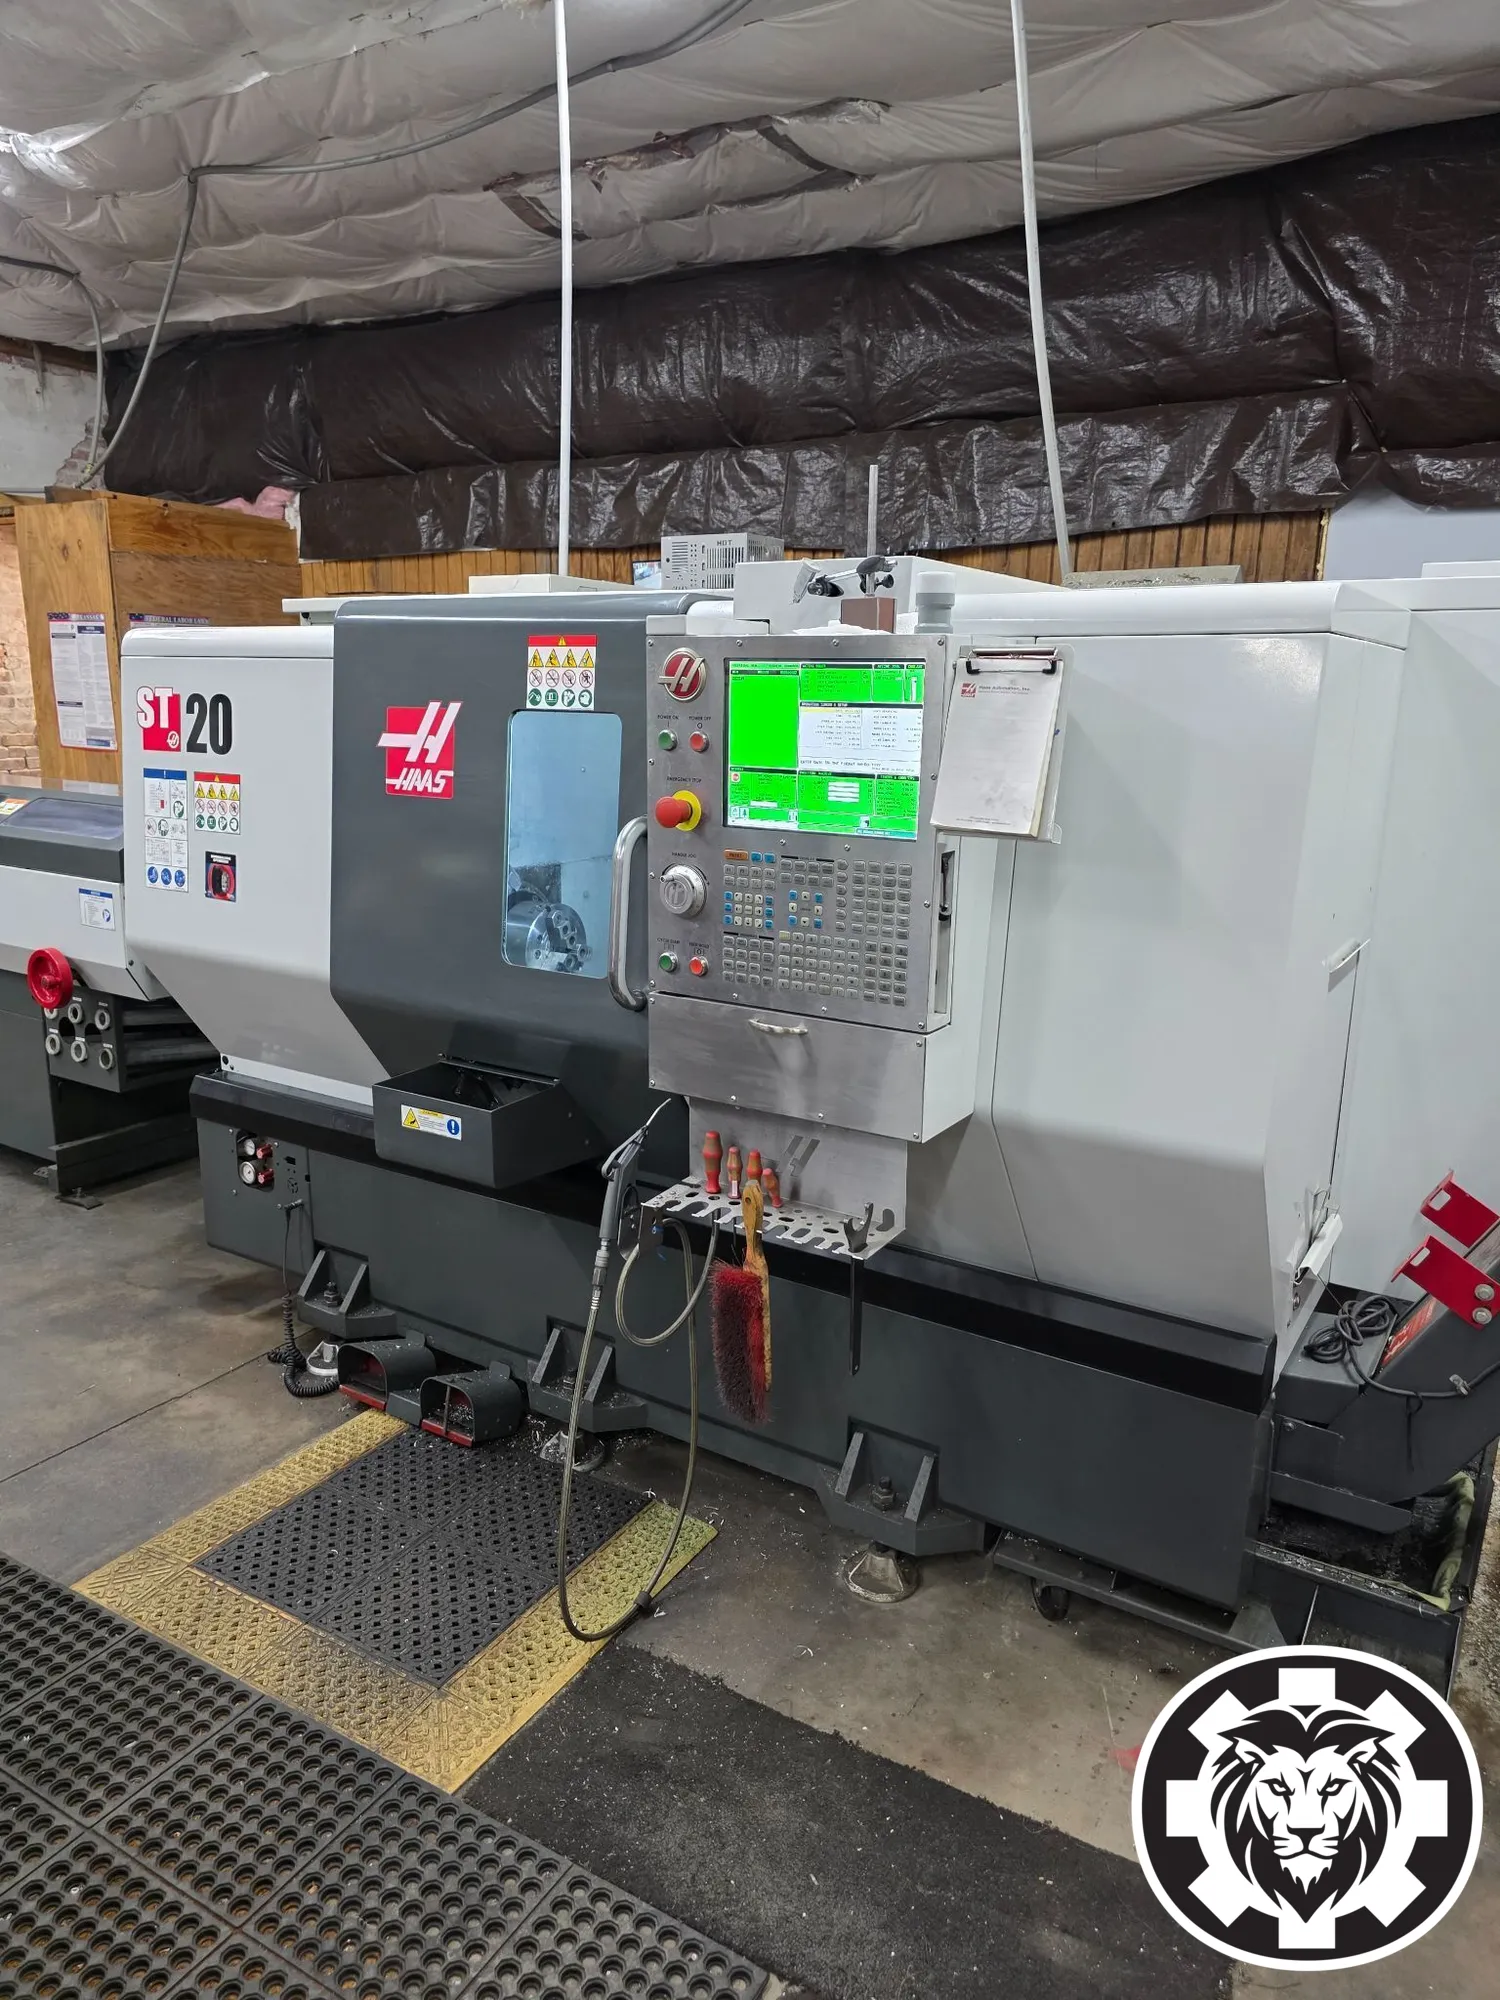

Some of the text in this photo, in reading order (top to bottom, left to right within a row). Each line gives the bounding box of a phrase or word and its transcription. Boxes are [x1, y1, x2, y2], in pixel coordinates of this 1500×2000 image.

[136, 685, 233, 755] ST 20
[385, 767, 454, 793] HAAS
